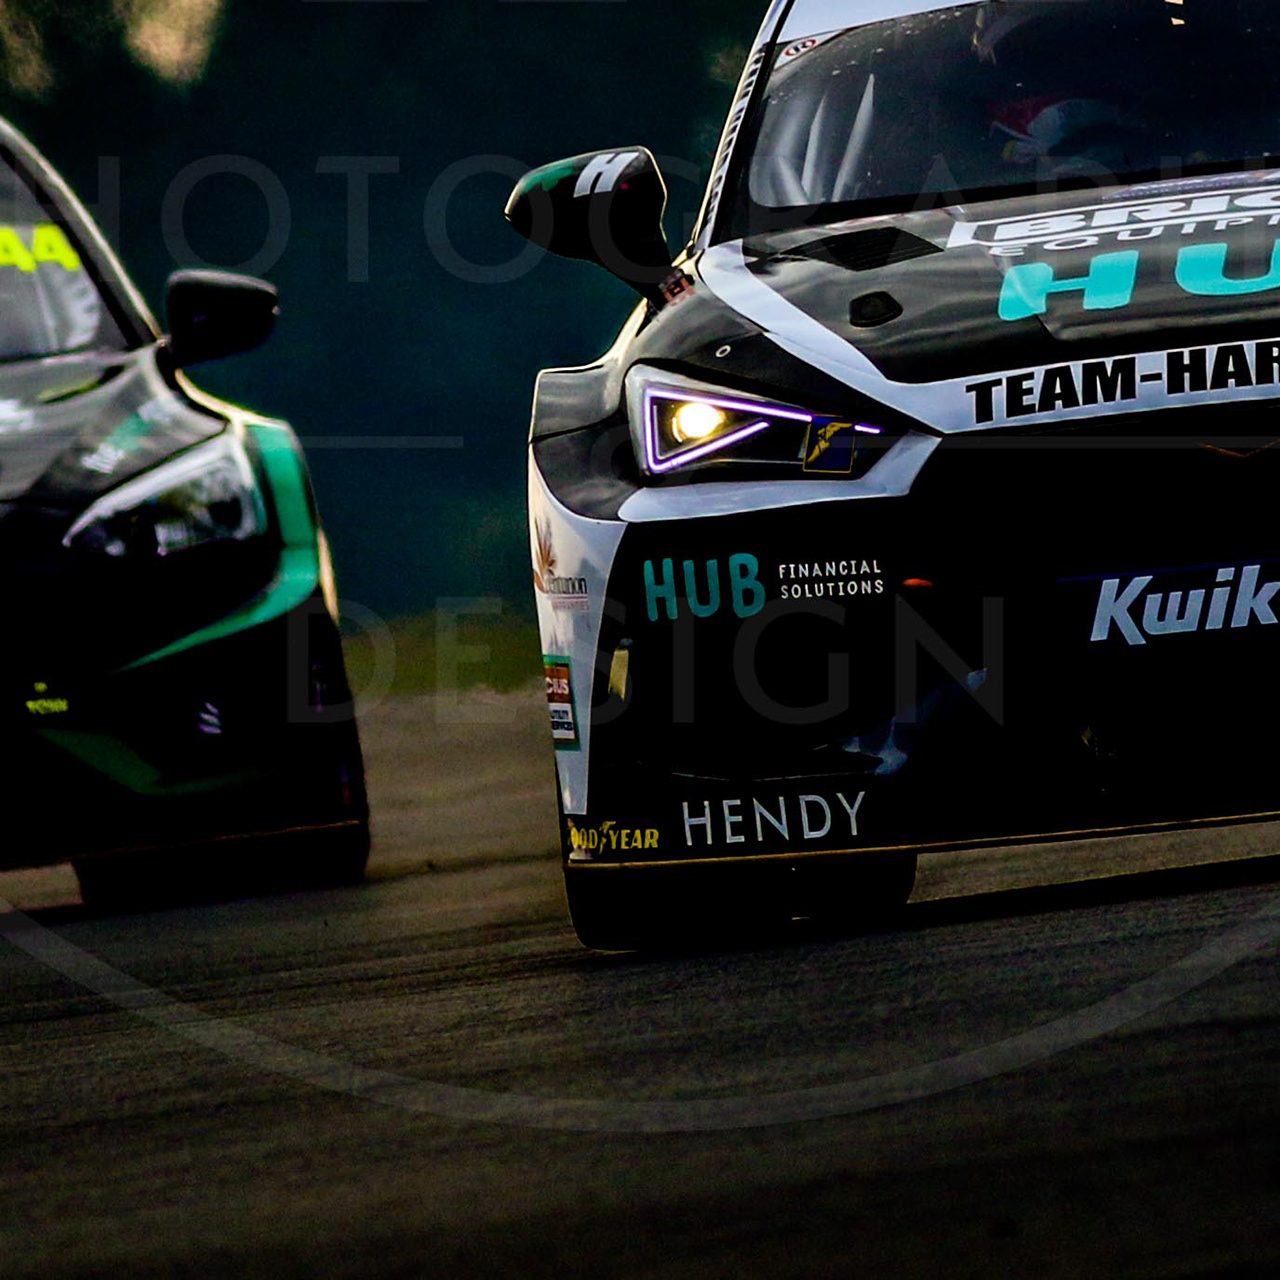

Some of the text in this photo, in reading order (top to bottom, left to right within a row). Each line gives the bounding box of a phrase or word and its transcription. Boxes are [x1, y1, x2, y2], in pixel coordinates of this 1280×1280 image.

[643, 552, 882, 622] HUB FINANCIAL
[780, 578, 884, 600] SOLUTIONS
[682, 790, 866, 847] HENDY
